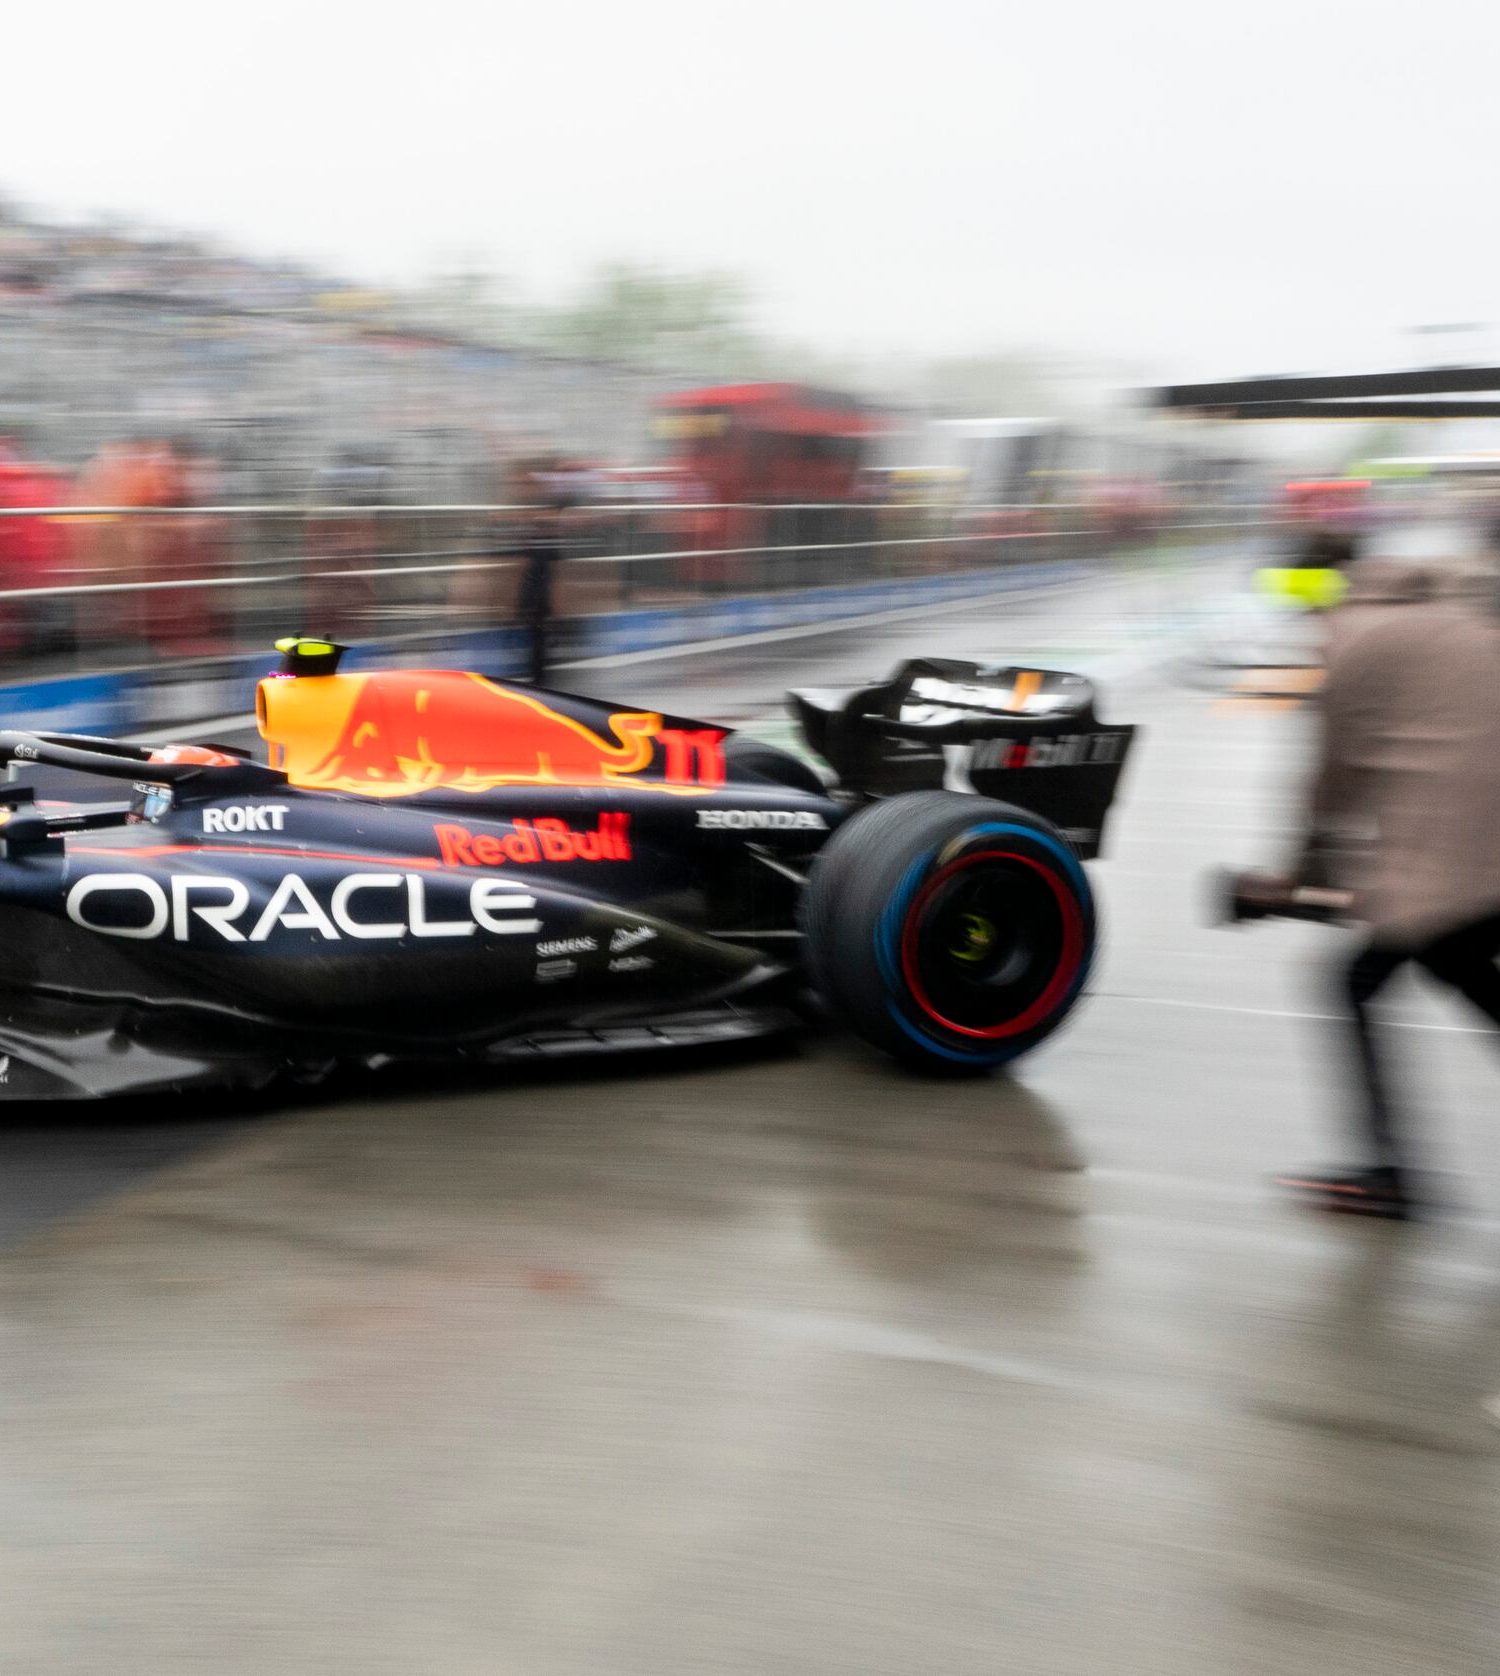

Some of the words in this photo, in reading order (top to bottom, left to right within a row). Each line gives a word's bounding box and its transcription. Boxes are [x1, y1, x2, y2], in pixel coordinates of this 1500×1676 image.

[655, 729, 727, 785] 11
[202, 805, 290, 833] ROKT
[695, 810, 831, 830] HONDA
[66, 873, 545, 942] ORACLE
